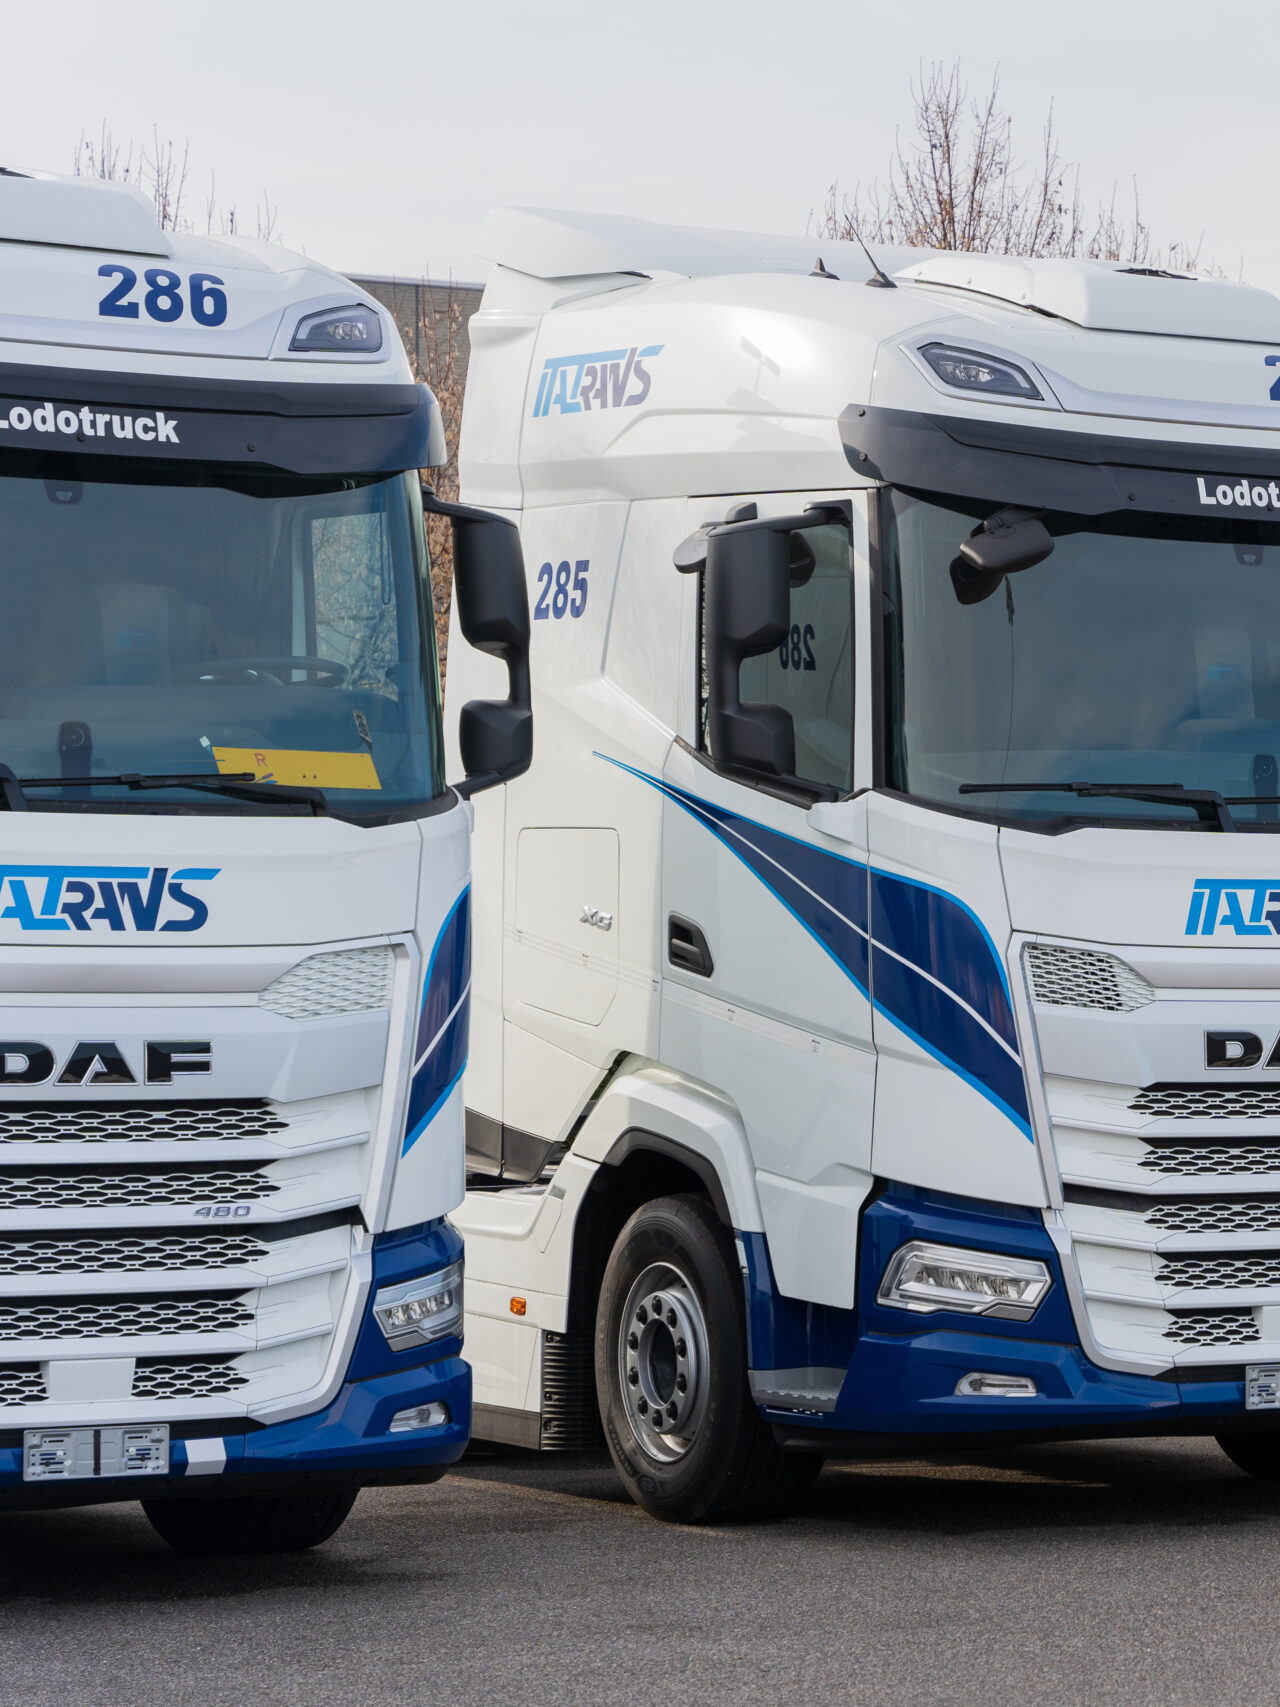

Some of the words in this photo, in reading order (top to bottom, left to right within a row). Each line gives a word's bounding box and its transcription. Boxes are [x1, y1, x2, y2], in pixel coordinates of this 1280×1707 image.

[97, 264, 228, 327] 286
[533, 559, 590, 621] 285
[0, 1039, 213, 1086] DAF
[193, 1204, 251, 1219] 480
